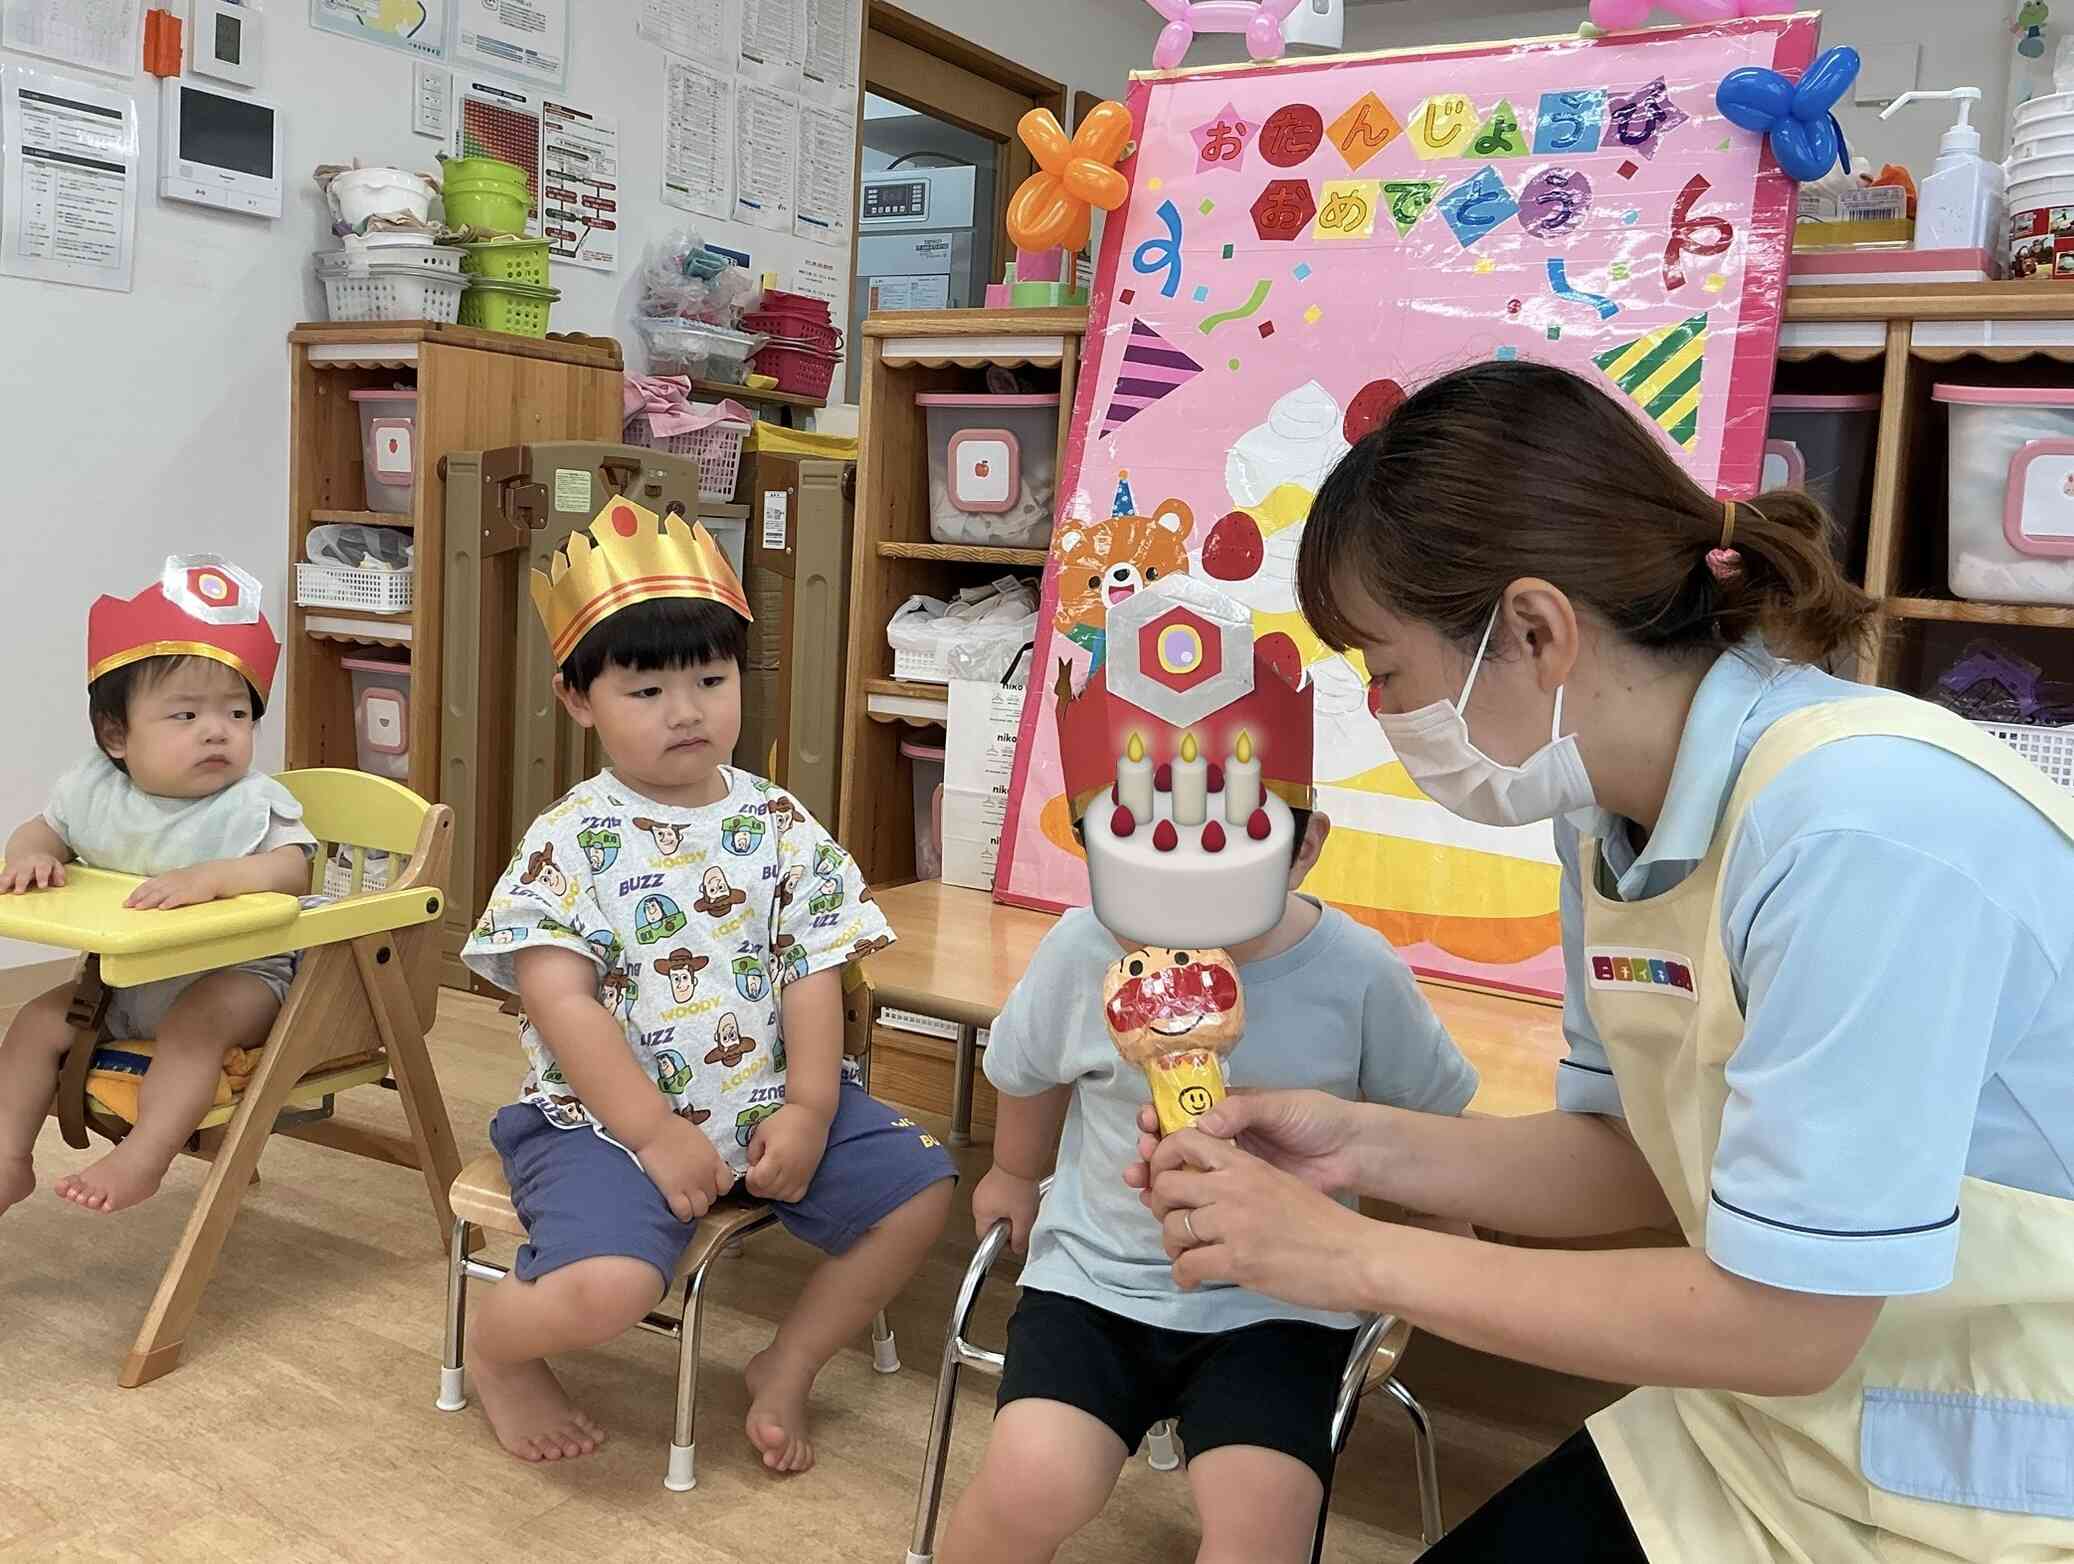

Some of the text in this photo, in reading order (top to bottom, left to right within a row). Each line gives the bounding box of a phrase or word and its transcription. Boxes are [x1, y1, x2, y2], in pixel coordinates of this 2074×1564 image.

[1201, 76, 1667, 162] おたんじょうび
[1263, 174, 1574, 232] おめでとう
[997, 733, 1017, 743] niko
[619, 873, 665, 896] BUZZ
